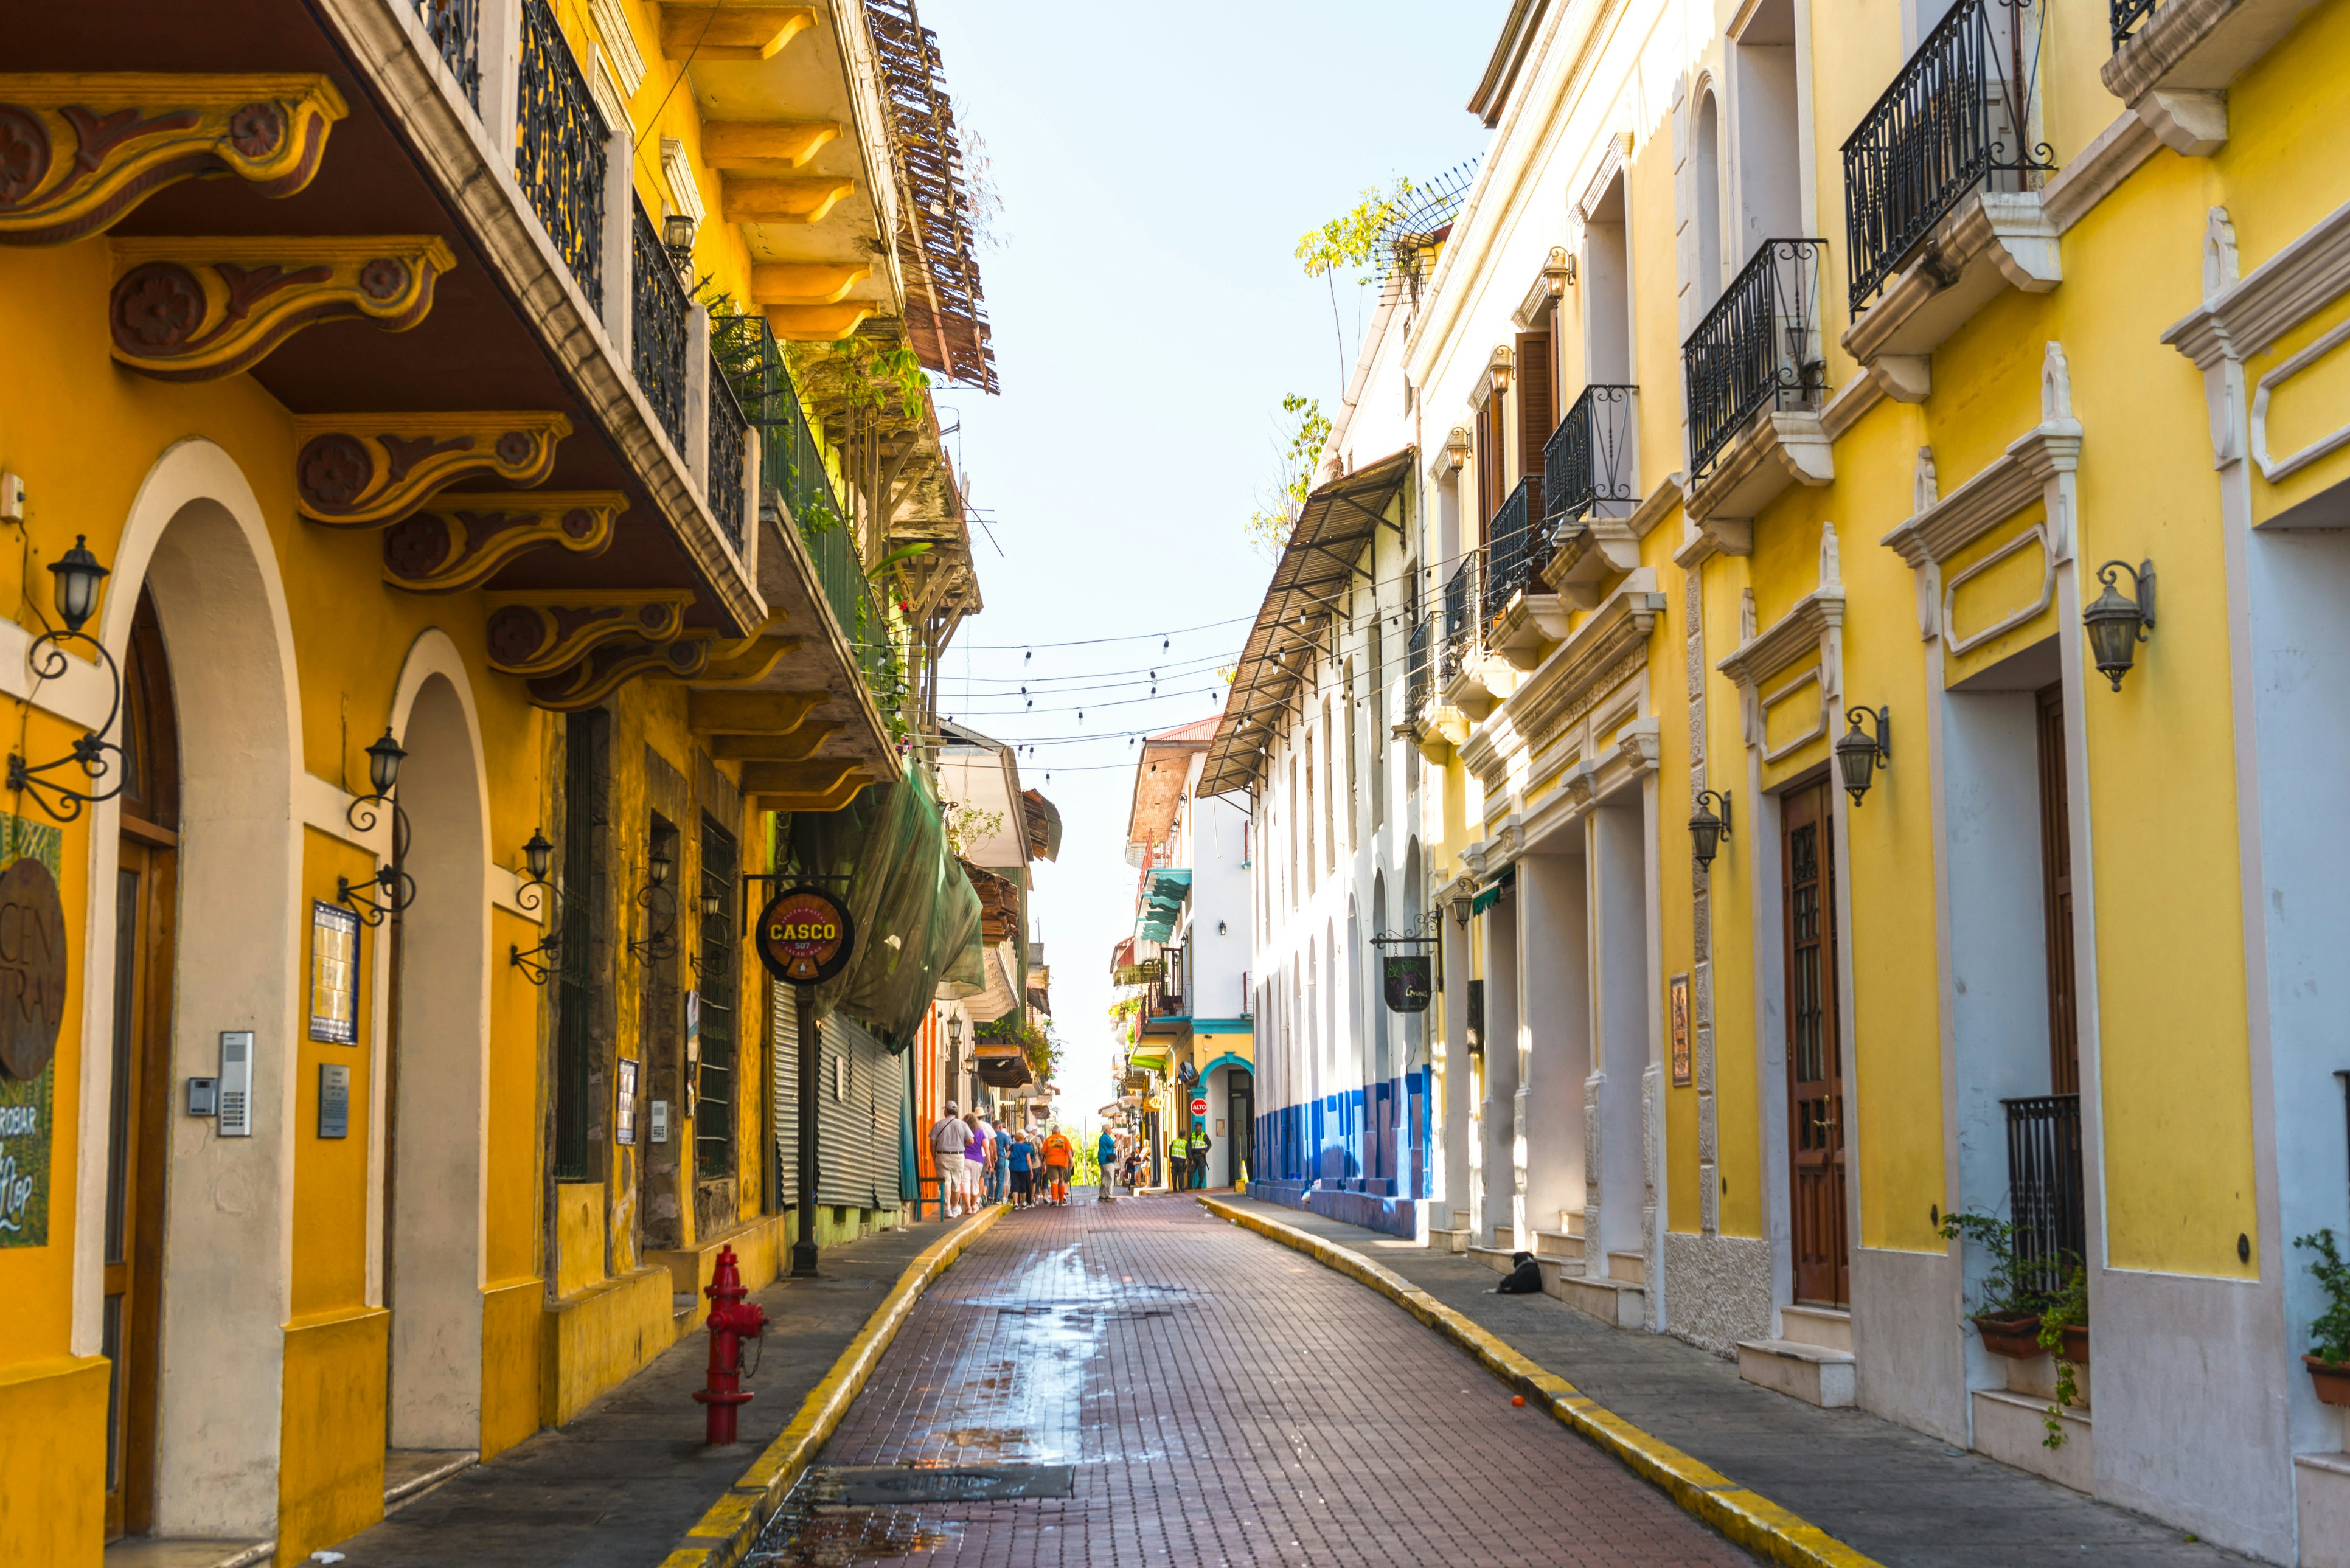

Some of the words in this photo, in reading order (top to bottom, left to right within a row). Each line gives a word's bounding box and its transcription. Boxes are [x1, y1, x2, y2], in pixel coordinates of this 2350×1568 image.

[0, 902, 54, 965] CEN
[770, 924, 836, 940] CASCO
[785, 946, 805, 957] SALAD
[810, 946, 822, 955] BAR
